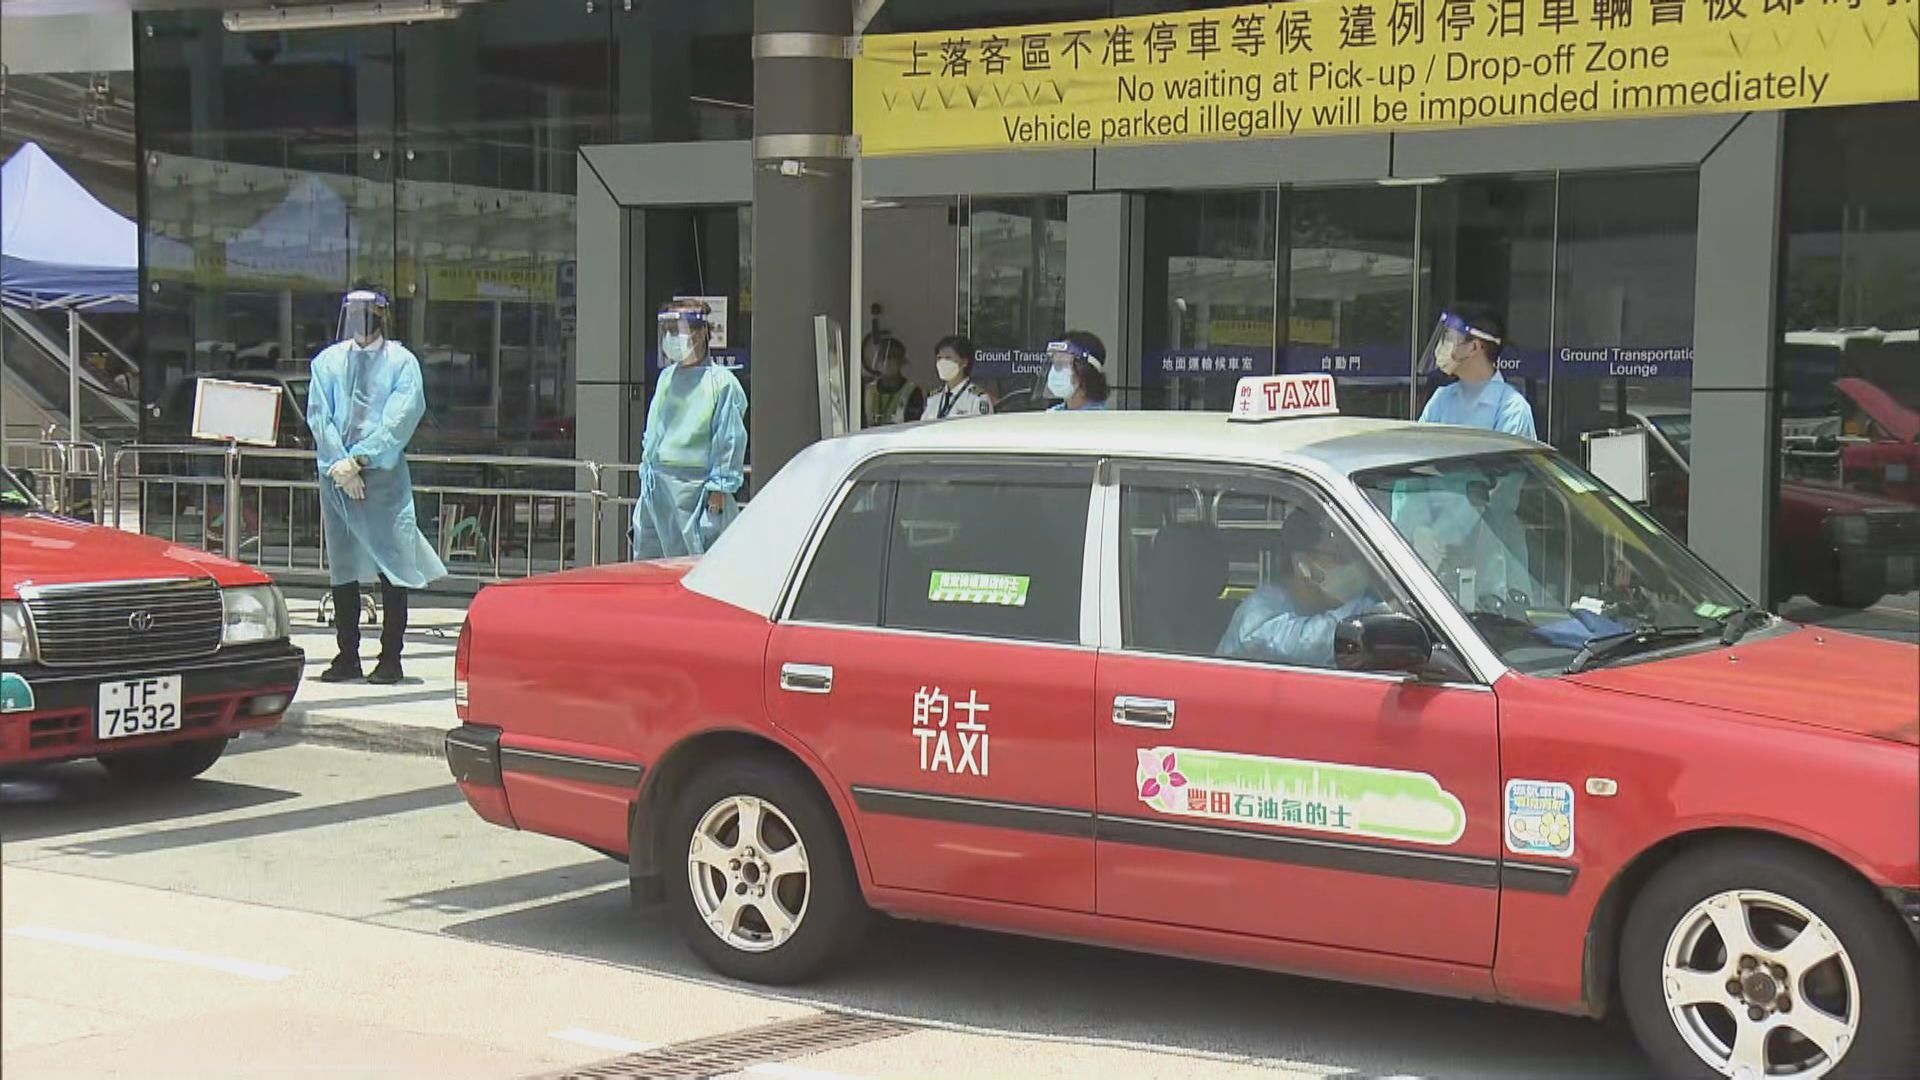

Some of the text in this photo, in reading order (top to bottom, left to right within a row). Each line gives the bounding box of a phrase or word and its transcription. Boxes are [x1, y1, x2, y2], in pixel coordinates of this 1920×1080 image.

[901, 10, 1313, 79] 上落客區不准停車等候
[1117, 41, 1669, 103] No waiting at Pick-up / Drop-off Zone
[1003, 66, 1829, 144] Vehicle parked illegally will be impounded immediately
[975, 350, 1049, 364] Ground Transp
[1012, 362, 1042, 375] Loung
[1162, 356, 1253, 371] 地面運輸候車室
[1321, 356, 1361, 371] 自動門
[1560, 348, 1694, 364] Ground Transportatio
[1609, 362, 1658, 377] Lounge
[1240, 385, 1251, 411] 的士
[1263, 378, 1331, 411] TAXI
[124, 681, 158, 707] TF
[105, 704, 175, 735] 7532
[913, 686, 990, 731] 的士
[912, 728, 989, 776] TAXI
[1187, 788, 1352, 829] 豐田石油氣的士
